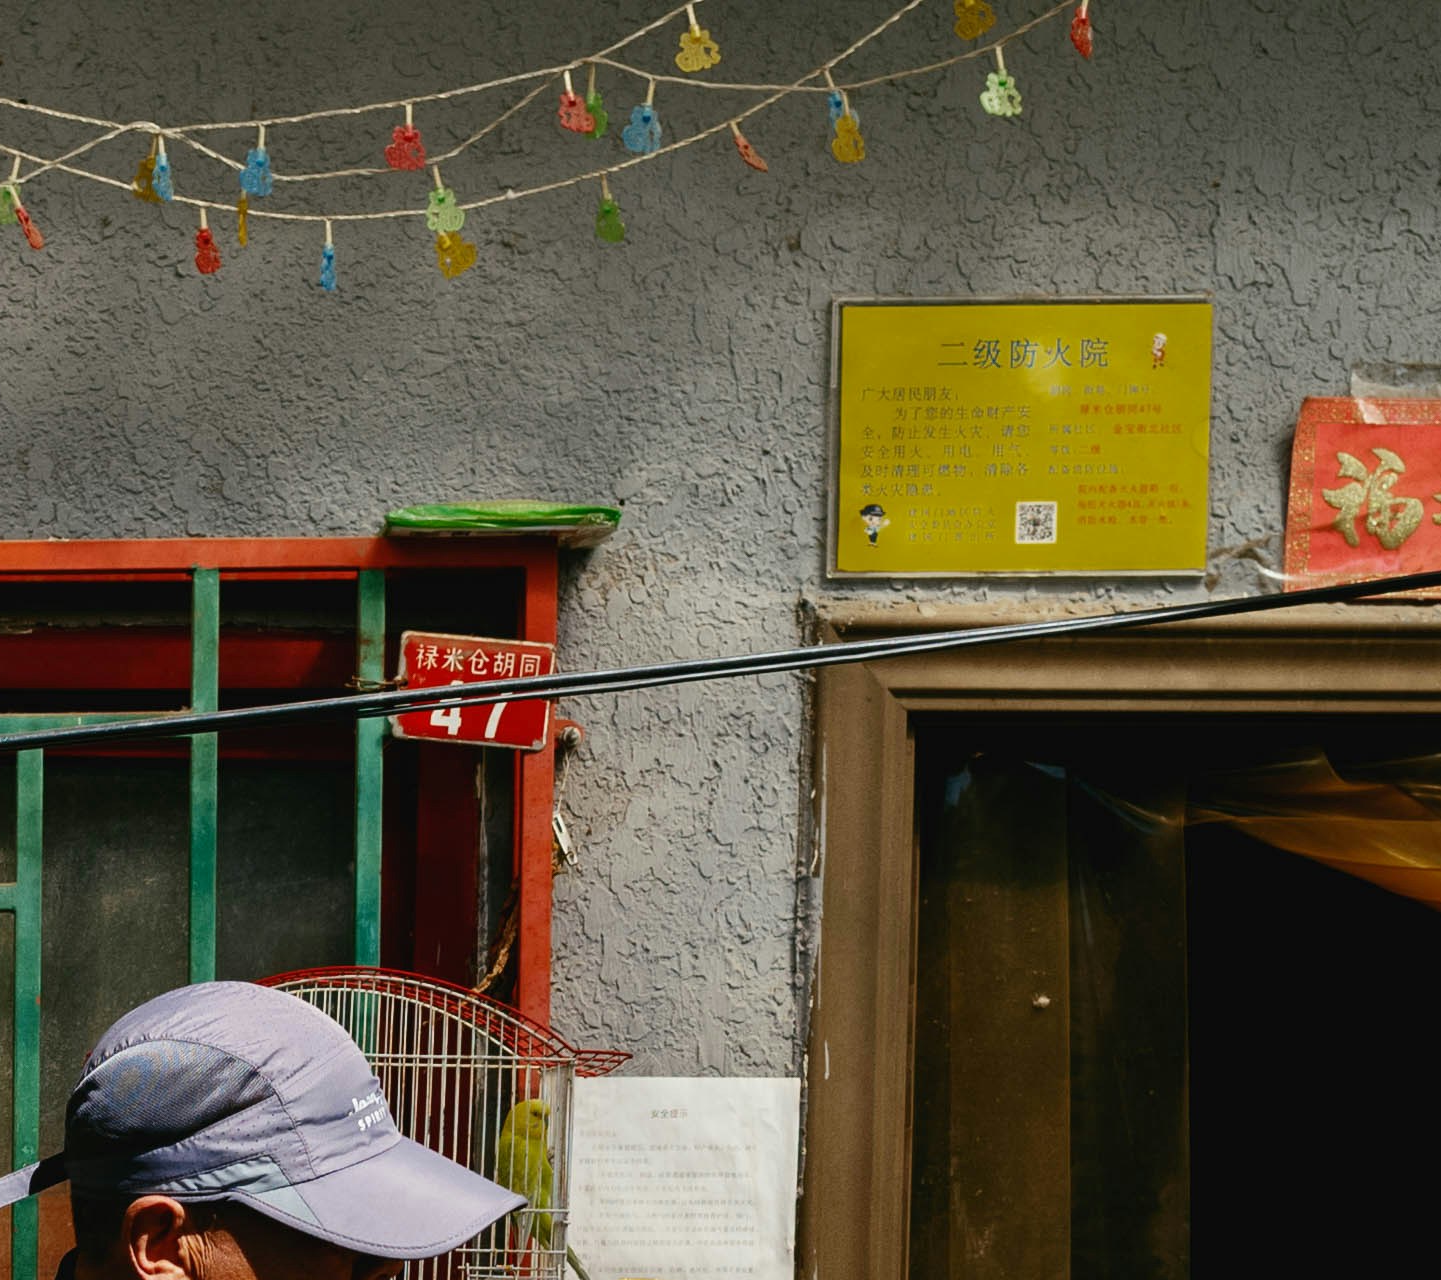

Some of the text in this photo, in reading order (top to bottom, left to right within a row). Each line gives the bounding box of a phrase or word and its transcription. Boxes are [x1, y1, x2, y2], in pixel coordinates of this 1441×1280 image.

[937, 338, 1110, 370] 二级防火院
[894, 406, 1032, 421] 为了您的生命财产安
[416, 643, 542, 678] 禄米仓胡同
[430, 680, 514, 739] 47
